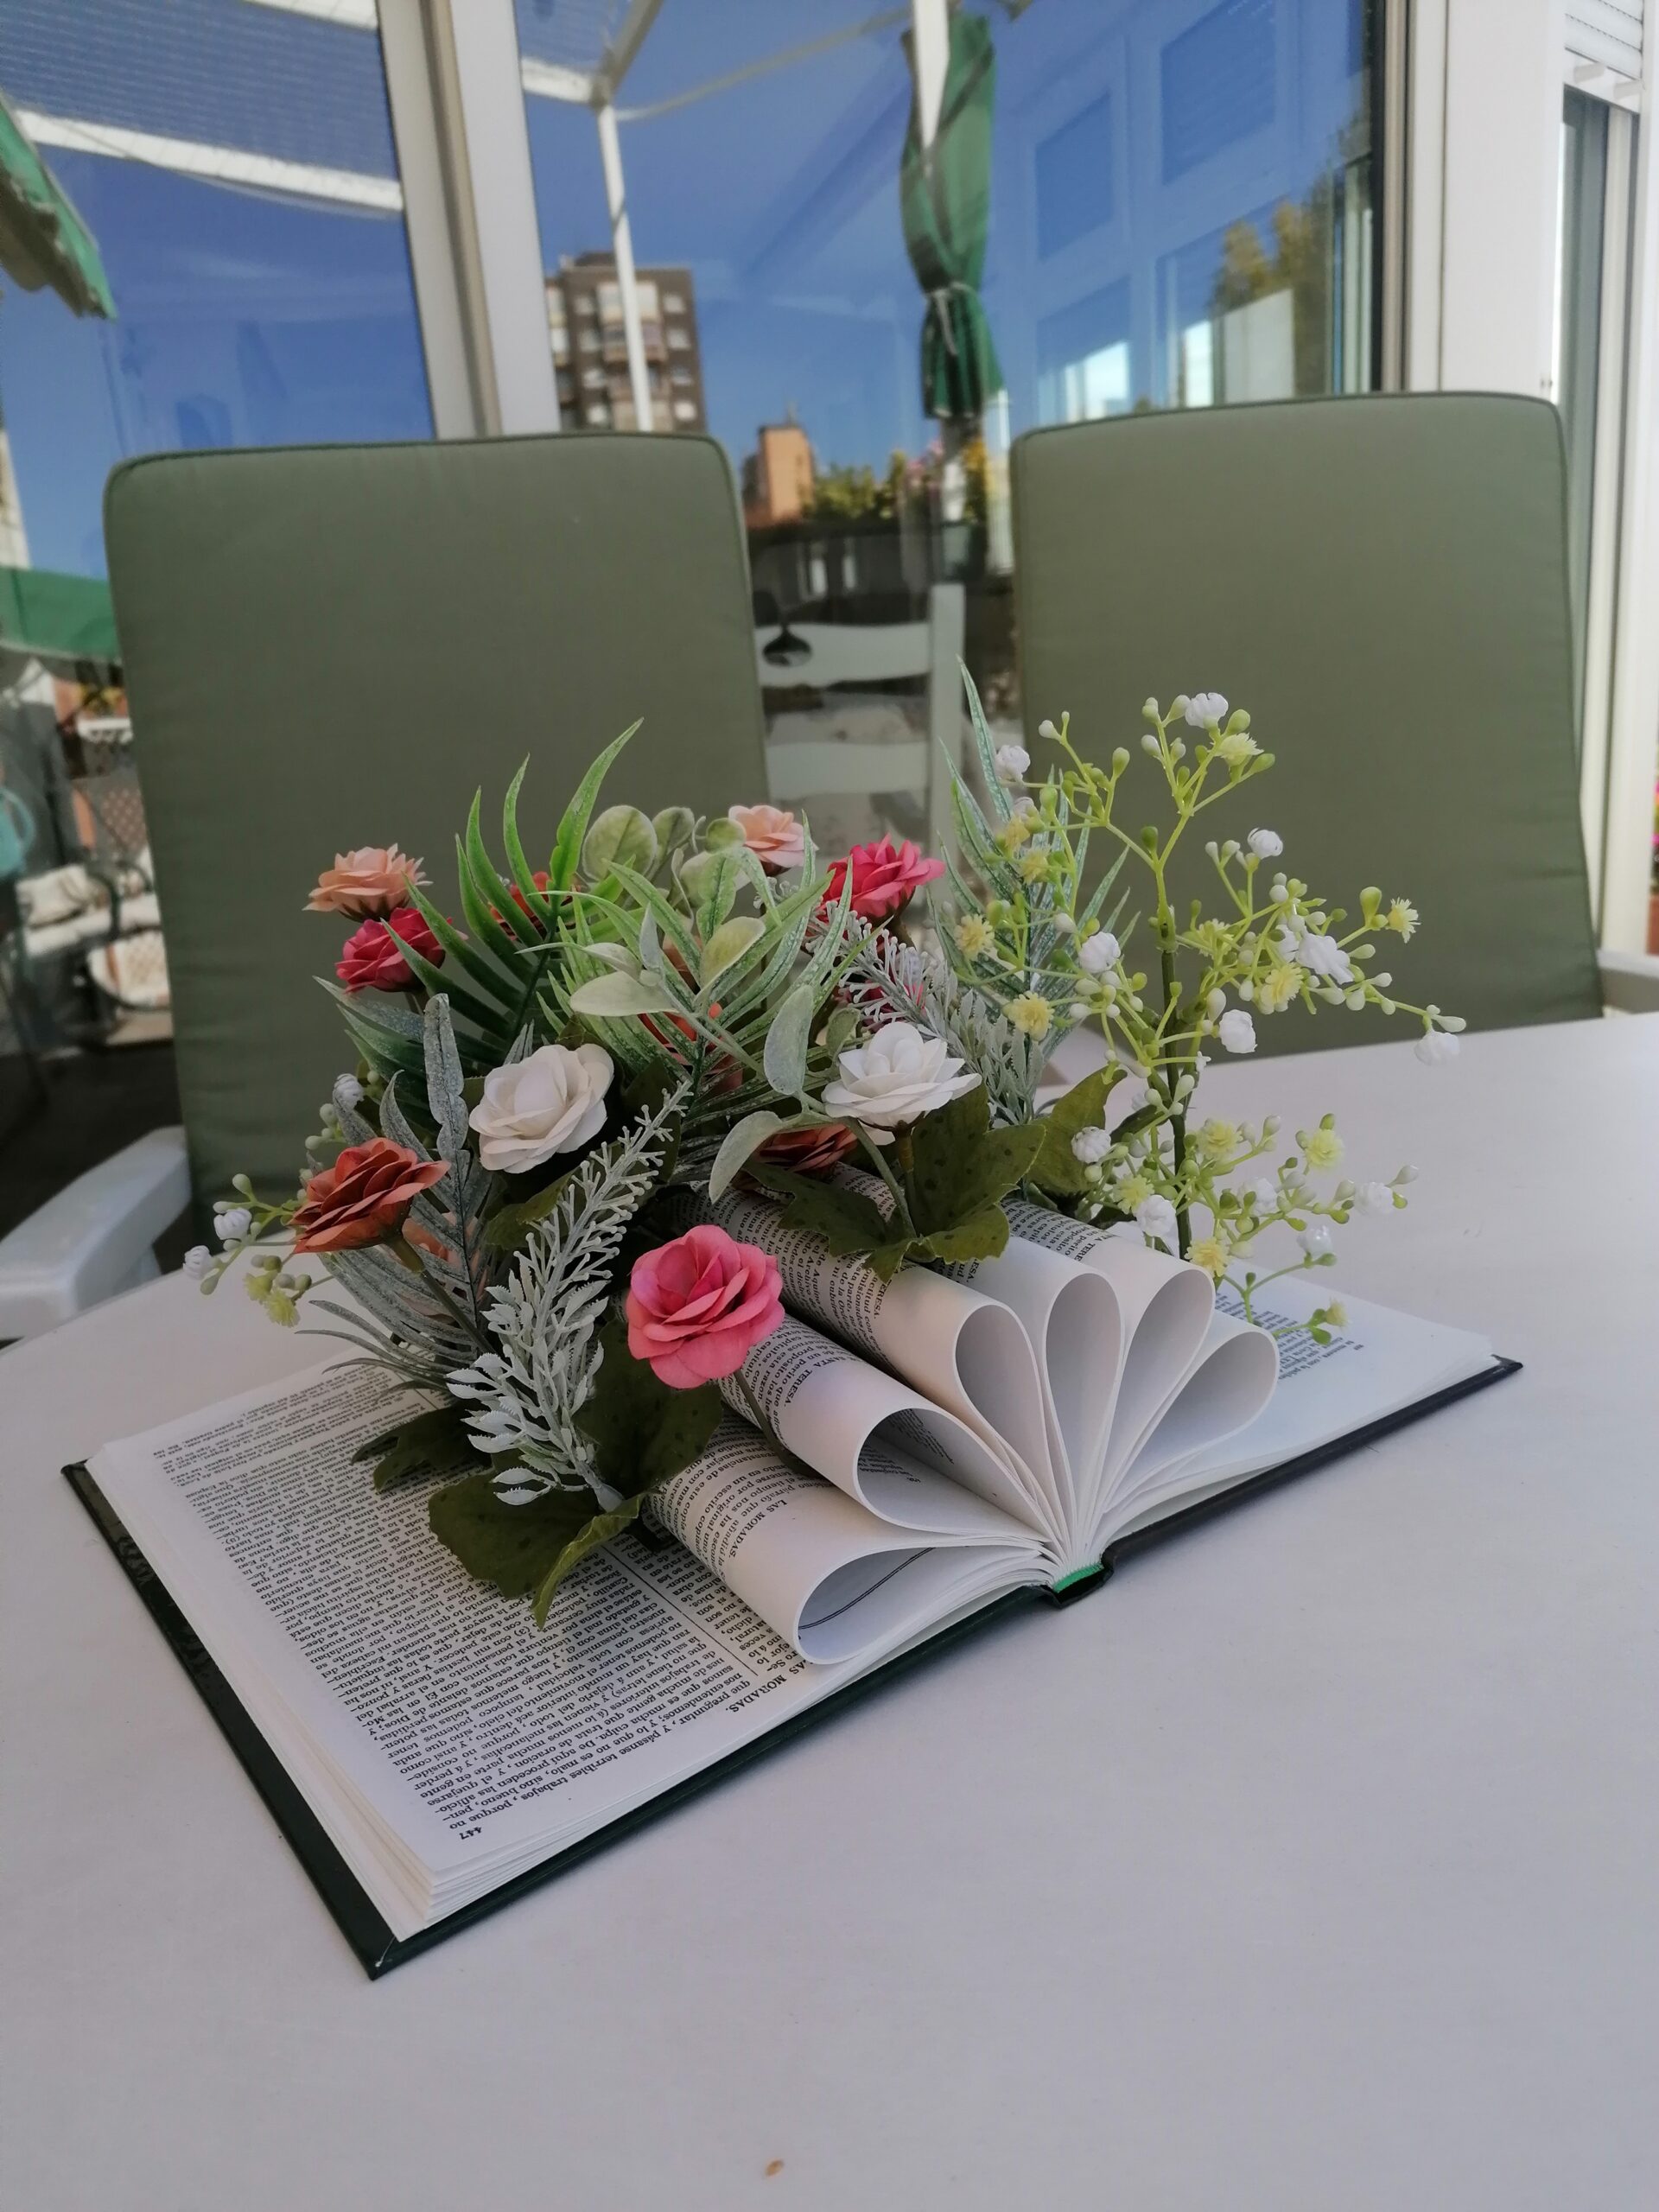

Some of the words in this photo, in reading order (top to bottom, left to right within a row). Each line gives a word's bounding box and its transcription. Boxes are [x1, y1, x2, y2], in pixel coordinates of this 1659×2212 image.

[1064, 1234, 1087, 1256] perito
[1072, 1242, 1096, 1262] TERE
[855, 1266, 874, 1328] omisionados
[873, 1278, 893, 1319] ERESA.
[744, 1340, 772, 1378] capítulo
[768, 1351, 786, 1369] esta
[773, 1345, 815, 1379] propósito
[747, 1369, 760, 1393] com
[781, 1357, 807, 1385] perito
[783, 1368, 813, 1407] TERESA.
[705, 1449, 744, 1470] manejar
[687, 1468, 704, 1484] con
[676, 1484, 690, 1507] mas
[688, 1481, 705, 1501] esta
[736, 1480, 755, 1495] por
[749, 1479, 785, 1497] tiempo
[760, 1482, 796, 1503] párrafo
[703, 1484, 732, 1514] escrito
[730, 1497, 749, 1512] nos
[740, 1501, 759, 1516] que
[765, 1498, 788, 1512] LAS
[679, 1501, 690, 1531] copia
[706, 1493, 735, 1531] original
[719, 1519, 739, 1555] añadió
[728, 1510, 766, 1558] MORADAS.
[693, 1569, 714, 1583] con
[693, 1574, 722, 1595] almas
[671, 1581, 695, 1596] obra
[688, 1592, 715, 1607] Dios.
[695, 1603, 715, 1616] son
[604, 1599, 641, 1622] gastado
[703, 1610, 723, 1623] son
[713, 1611, 741, 1630] tener
[582, 1619, 603, 1634] mal
[638, 1615, 674, 1636] apriesa
[720, 1616, 753, 1634] dicho,
[535, 1637, 572, 1656] tiempo
[613, 1636, 634, 1649] con
[738, 1632, 766, 1651] veces
[769, 1640, 792, 1657] ejor
[513, 1653, 535, 1667] que
[586, 1648, 612, 1662] toda
[704, 1656, 725, 1670] nes
[766, 1658, 786, 1672] Se-
[658, 1658, 701, 1684] trabajos
[701, 1664, 734, 1685] samos
[788, 1658, 807, 1675] AS
[469, 1665, 512, 1689] estamos
[655, 1675, 692, 1697] mucha
[722, 1672, 743, 1686] nos
[729, 1680, 751, 1694] que
[428, 1687, 468, 1708] delante
[608, 1681, 661, 1710] interiores
[680, 1683, 701, 1697] que
[724, 1674, 787, 1713] MORADAS.
[478, 1693, 524, 1717] tampoco
[626, 1693, 657, 1713] gente
[657, 1682, 724, 1722] entendemos;
[378, 1713, 411, 1731] Dios;
[603, 1711, 625, 1726] que
[628, 1702, 667, 1724] mucha
[423, 1715, 474, 1743] podemos
[546, 1720, 584, 1742] menos
[573, 1723, 603, 1739] trata
[594, 1722, 629, 1740] culpa.
[612, 1731, 634, 1745] que
[387, 1741, 419, 1758] tener
[505, 1738, 546, 1759] mucha
[618, 1729, 662, 1755] pásanse
[473, 1756, 505, 1775] parte
[544, 1758, 580, 1775] malo,
[549, 1748, 576, 1765] aquí
[568, 1752, 618, 1779] terribles
[495, 1758, 550, 1787] proceden
[518, 1774, 543, 1789] sino
[419, 1778, 454, 1798] gente
[426, 1780, 479, 1806] quejarse
[474, 1786, 520, 1806] bueno,
[442, 1803, 474, 1821] pen-
[467, 1798, 513, 1821] porque
[457, 1825, 484, 1840] 447
